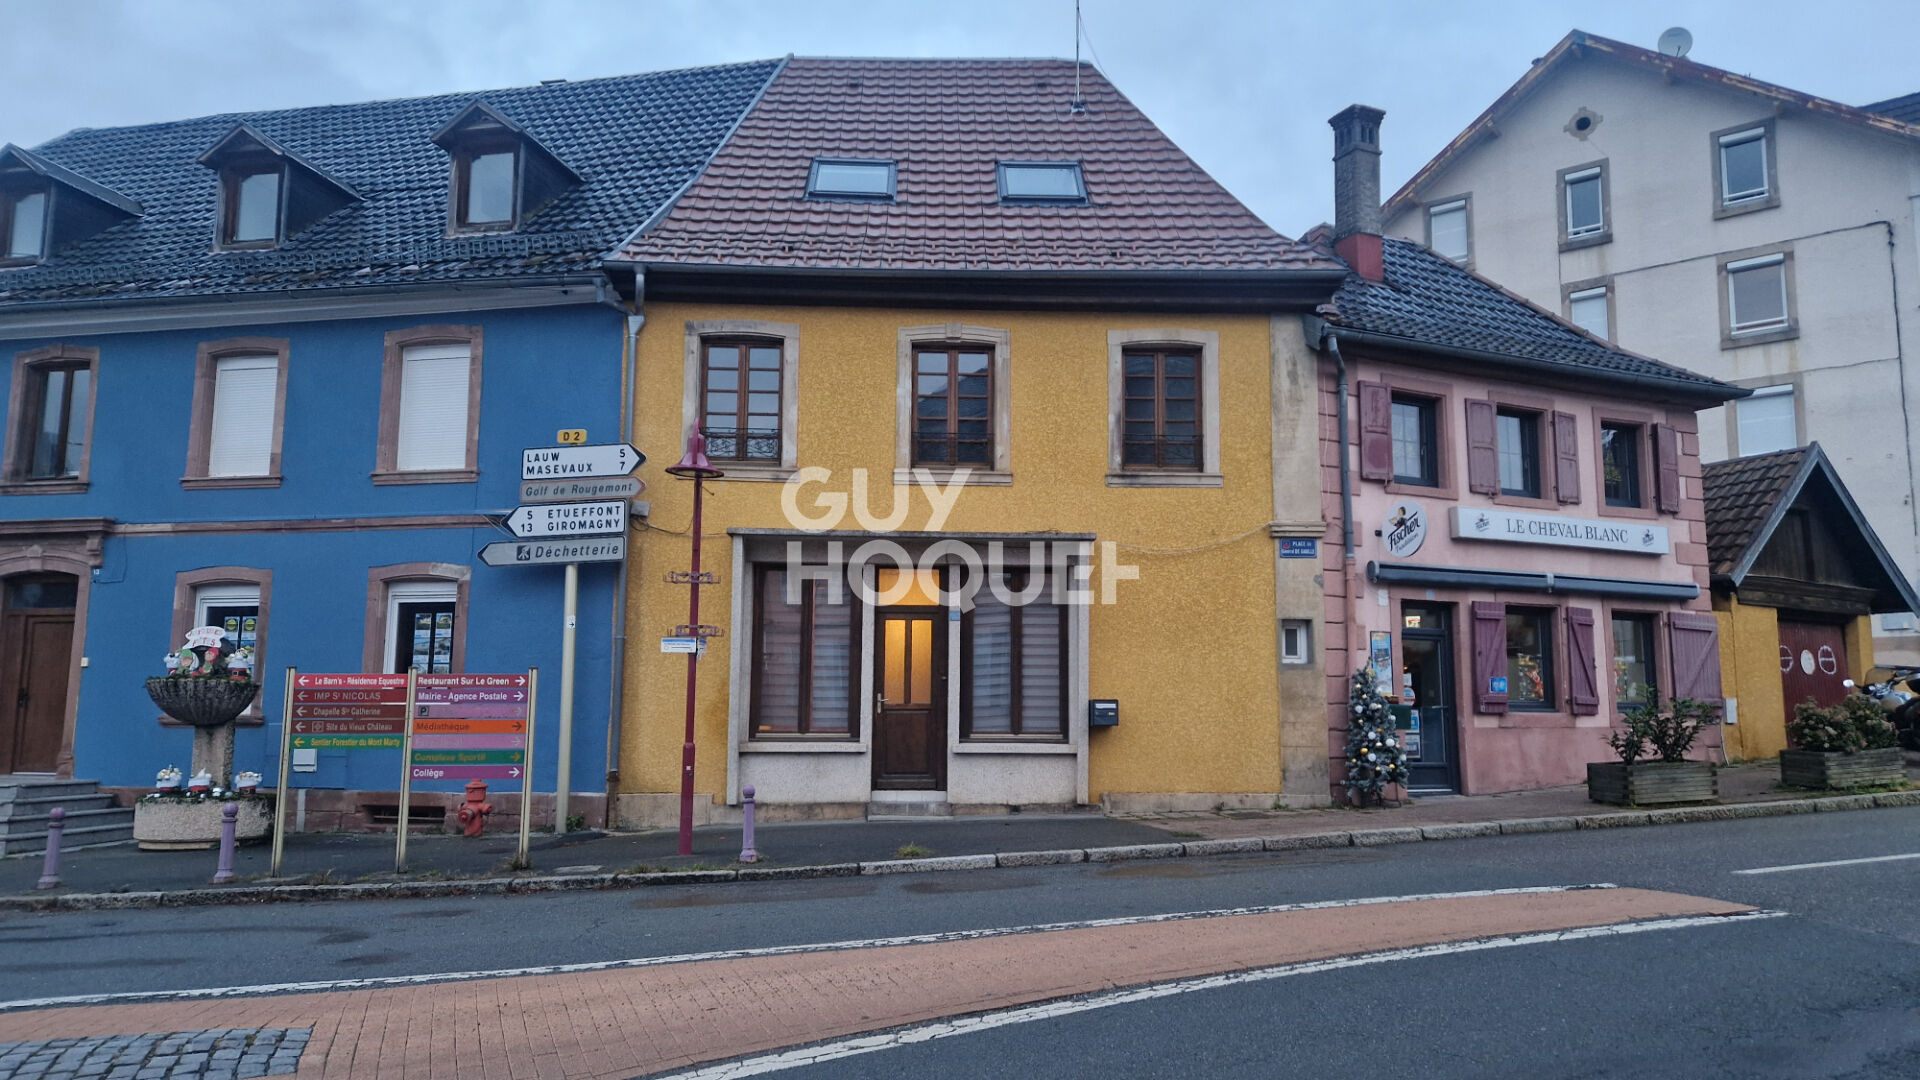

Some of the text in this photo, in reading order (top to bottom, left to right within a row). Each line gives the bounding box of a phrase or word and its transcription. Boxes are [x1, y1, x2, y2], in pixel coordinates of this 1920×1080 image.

[563, 431, 580, 441] D 2
[527, 449, 626, 462] LAUW 5
[526, 462, 626, 475] MASEVAUX 7
[526, 482, 632, 496] Golf de Rougemont
[527, 506, 621, 520] 5 ETUEFFONT
[521, 519, 620, 533] 13 GIROMAGNY
[1388, 510, 1420, 552] Fischer
[1506, 518, 1525, 533] LE
[1528, 520, 1583, 539] CHEVAL
[1585, 526, 1629, 544] BLANC
[535, 544, 619, 558] Déchetterie
[315, 677, 323, 685] Le
[347, 676, 377, 685] Résidence
[378, 677, 404, 686] Equestre
[418, 677, 510, 685] Restaurant Sur Le Green
[314, 692, 330, 700] IMP
[342, 692, 381, 700] NICOLAS
[418, 692, 442, 700] Mairie
[448, 692, 477, 702] Agence
[480, 692, 508, 700] Postale
[313, 707, 340, 716] Chapelle
[351, 707, 380, 715] Catherine
[326, 722, 393, 731] Site du Vieux Château
[416, 722, 470, 731] Médiathèque
[414, 753, 456, 762] Complexe
[413, 769, 444, 778] Collège
